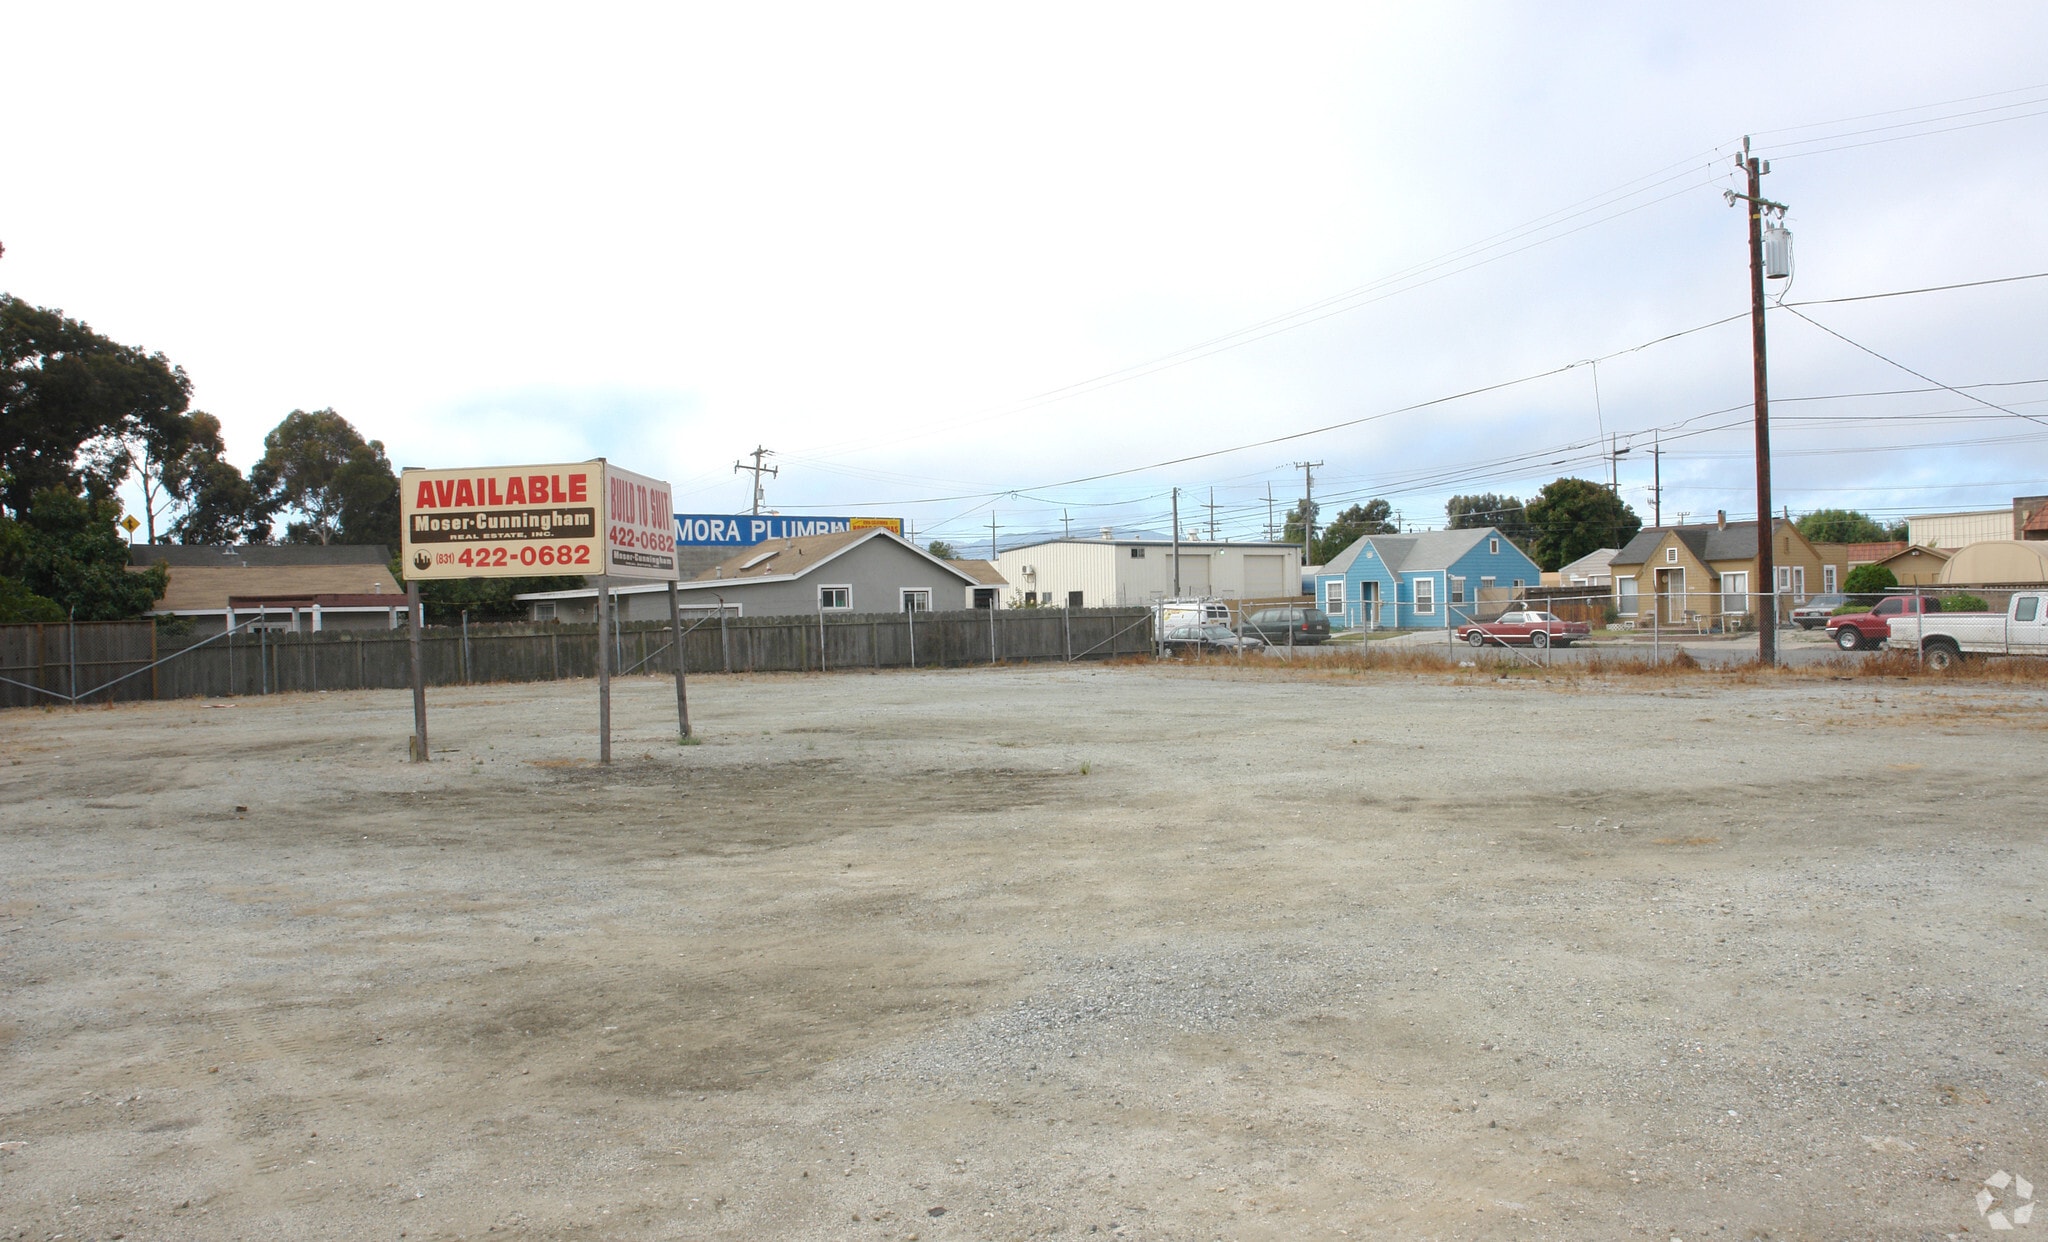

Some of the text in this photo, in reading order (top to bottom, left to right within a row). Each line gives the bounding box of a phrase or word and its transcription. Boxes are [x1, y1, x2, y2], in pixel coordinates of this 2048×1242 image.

[416, 474, 587, 508] AVAILABLE
[611, 477, 669, 531] BUILD TO SUIT
[609, 525, 674, 552] 422-0682
[436, 545, 590, 567] (831) 422-0682
